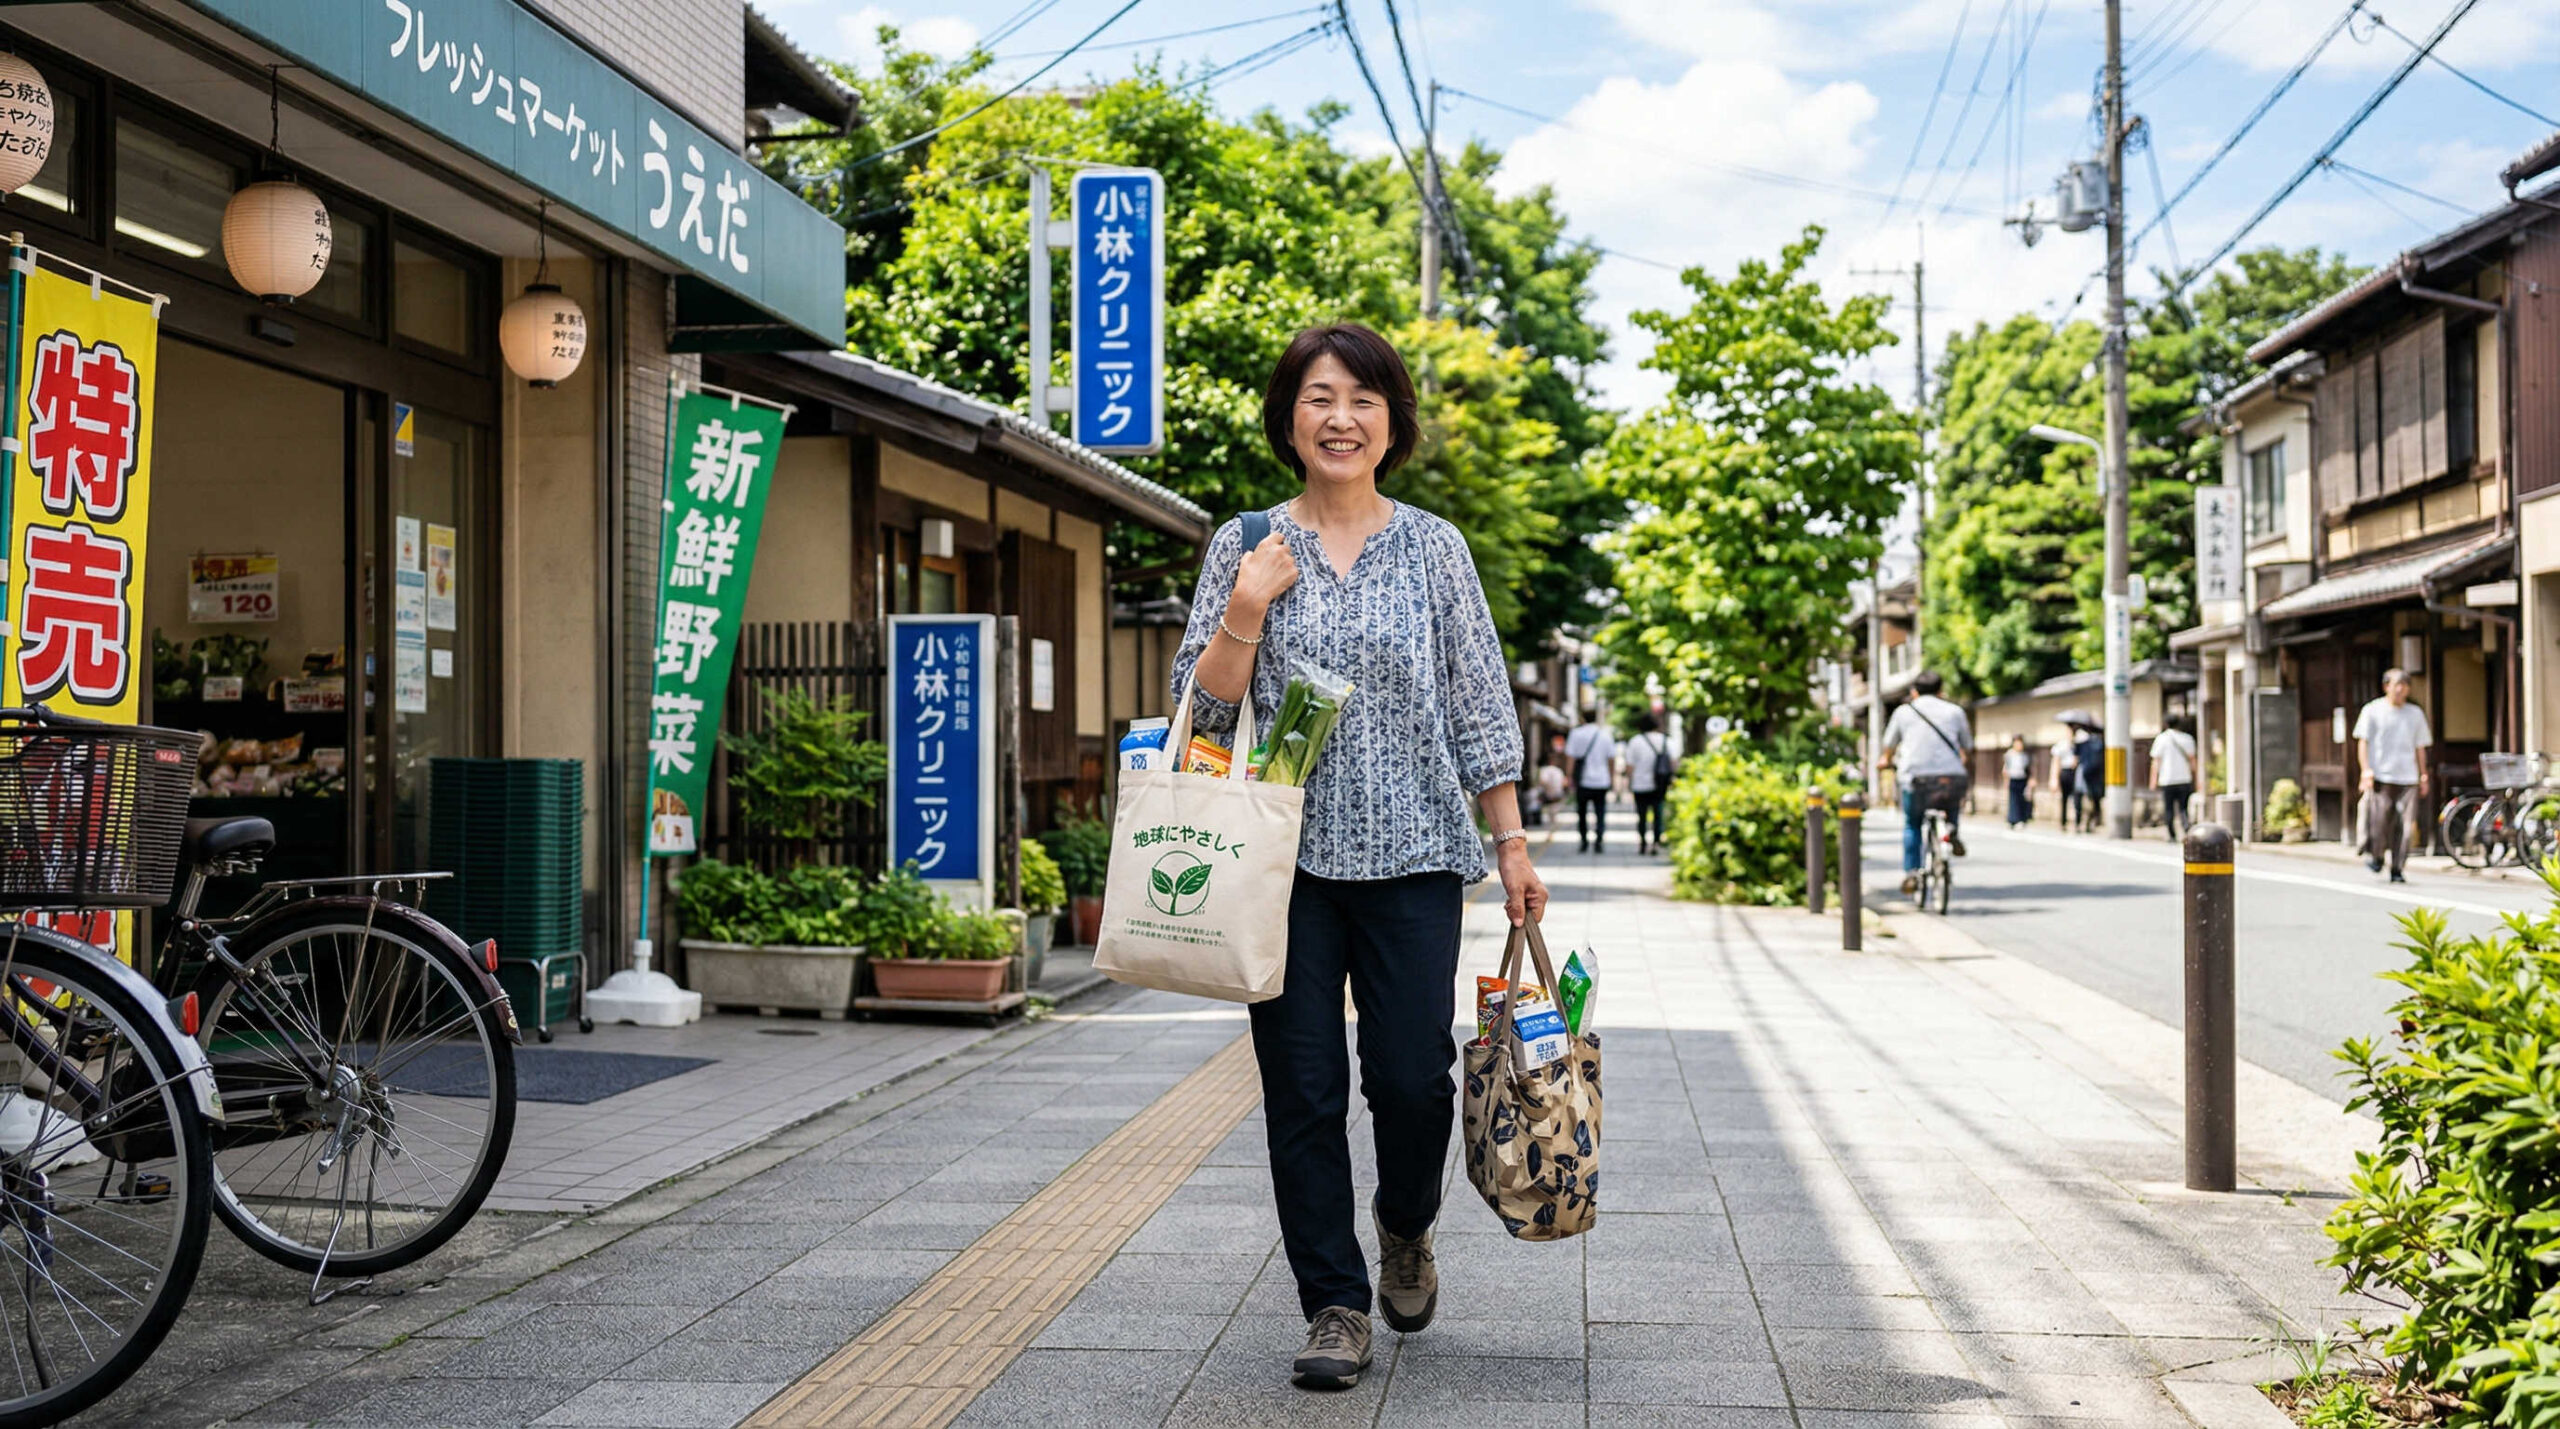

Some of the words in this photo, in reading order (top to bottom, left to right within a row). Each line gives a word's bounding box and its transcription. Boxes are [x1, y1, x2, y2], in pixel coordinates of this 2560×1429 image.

[386, 0, 625, 185] フレッシュマーケット
[643, 118, 750, 274] うえだ
[1094, 185, 1134, 438] 小林クリニック
[223, 594, 273, 614] 120
[649, 419, 763, 775] 新鮮野菜
[913, 632, 949, 871] 小林クリニック
[1133, 824, 1246, 859] 地球にやさしく
